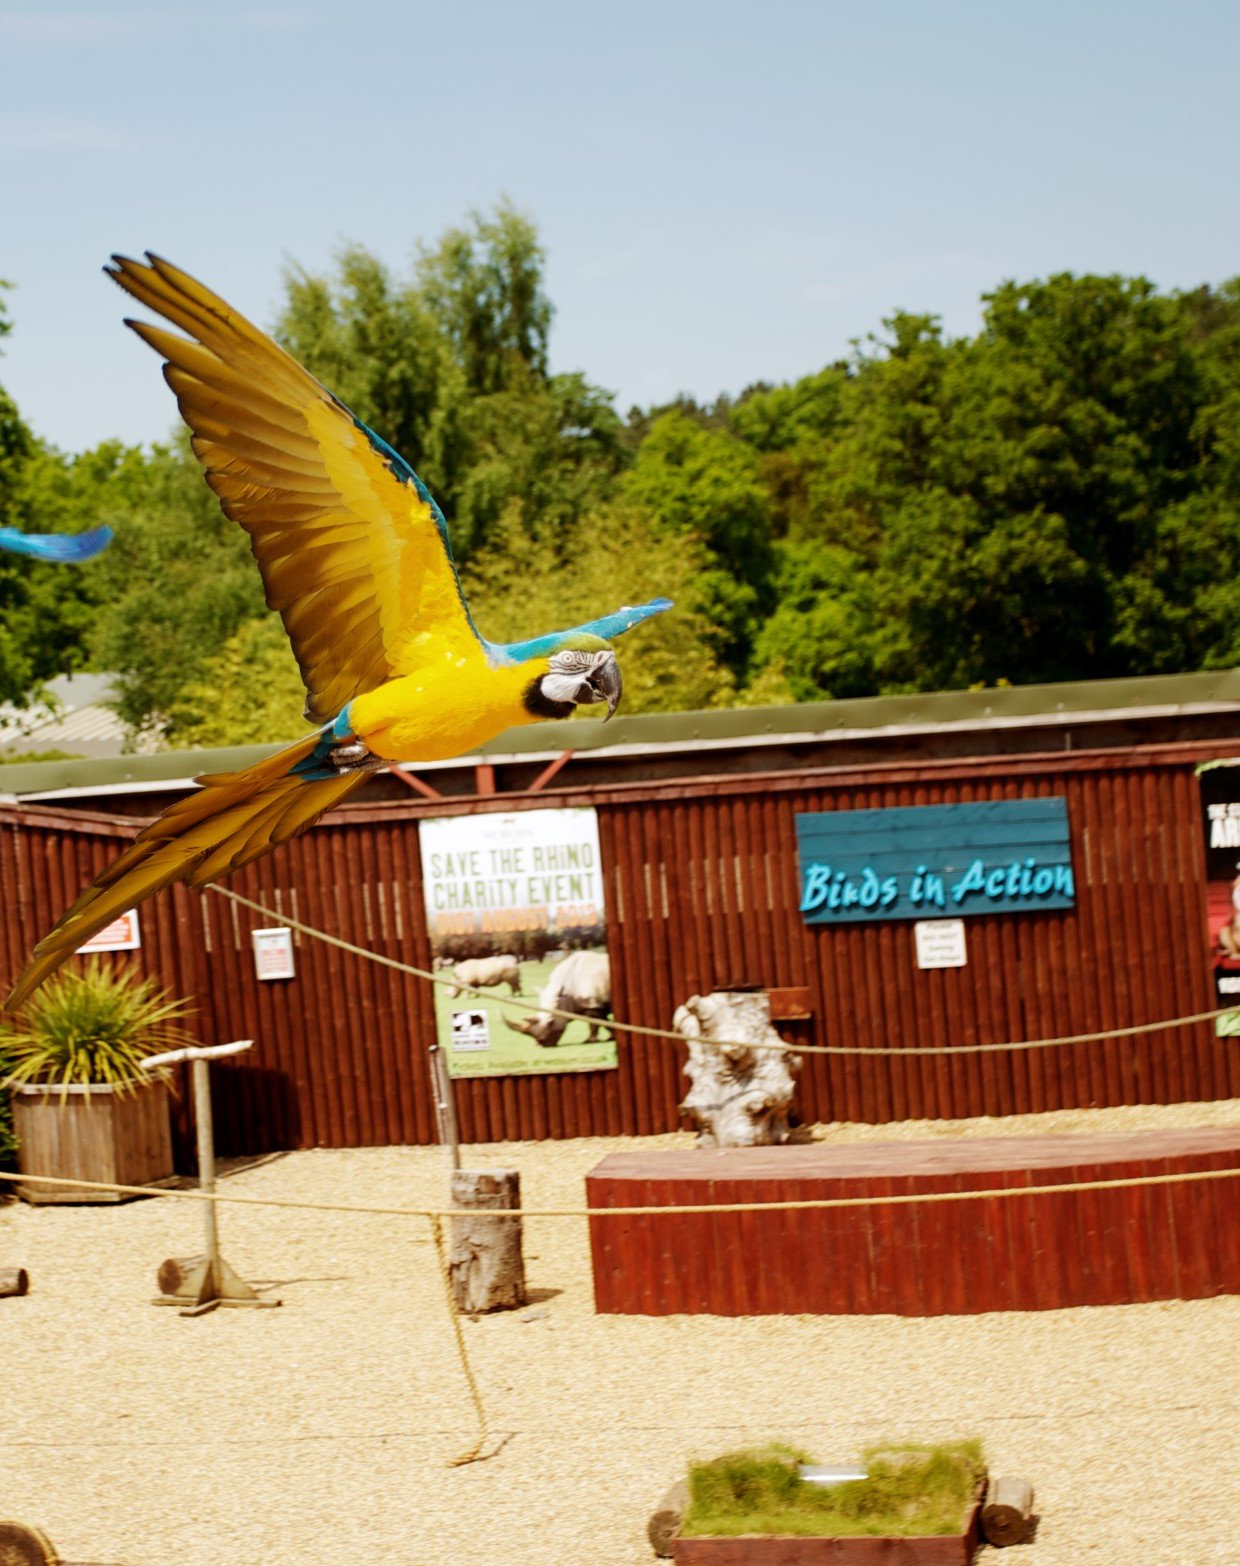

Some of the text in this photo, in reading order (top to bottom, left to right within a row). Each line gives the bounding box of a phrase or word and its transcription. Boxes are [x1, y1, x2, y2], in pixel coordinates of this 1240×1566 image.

[430, 850, 481, 879] SAVE
[489, 847, 525, 876] THE
[527, 872, 594, 904] EVENT
[799, 857, 1076, 912] Birds in Action
